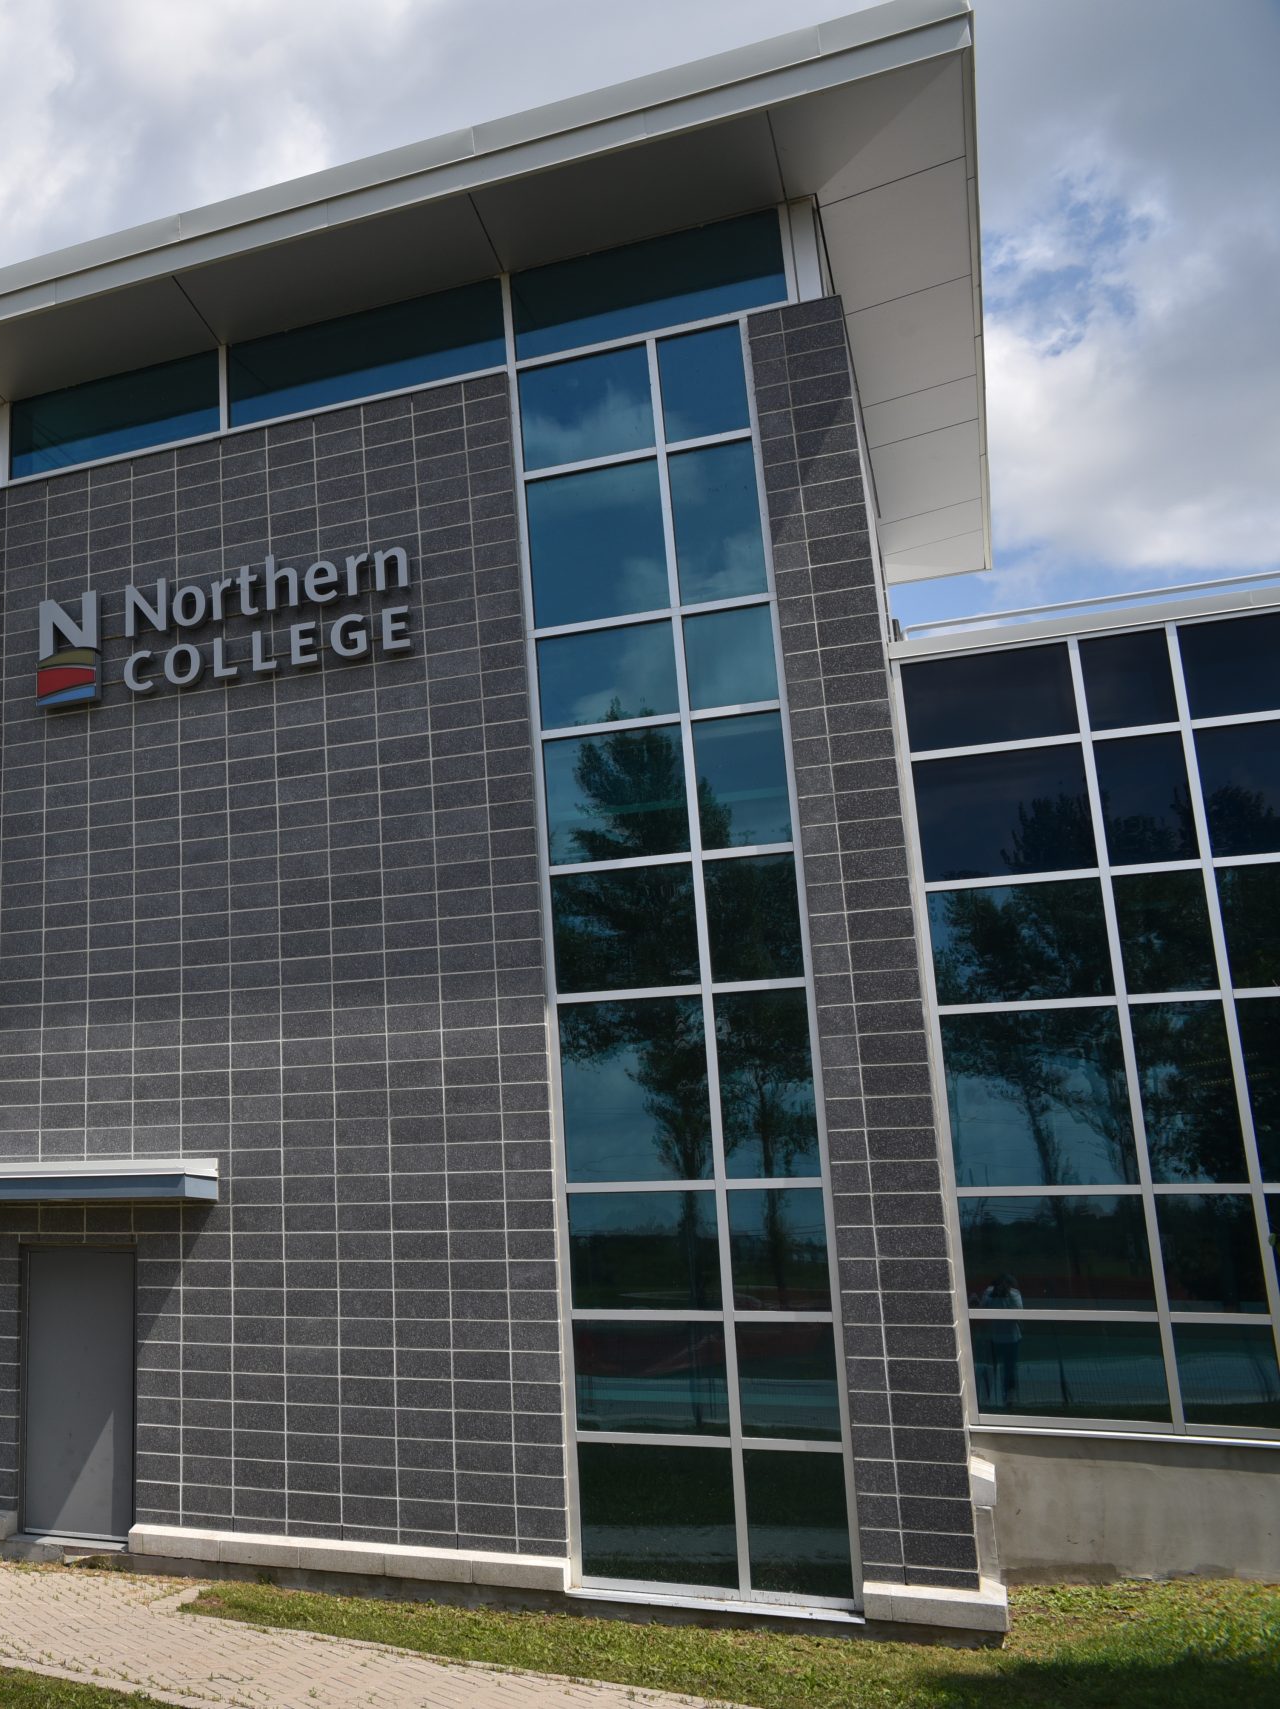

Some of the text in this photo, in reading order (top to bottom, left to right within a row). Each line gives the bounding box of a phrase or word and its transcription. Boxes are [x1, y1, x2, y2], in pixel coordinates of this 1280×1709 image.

[39, 590, 98, 661] N
[124, 546, 410, 638] Northern
[123, 605, 412, 692] COLLEGE
